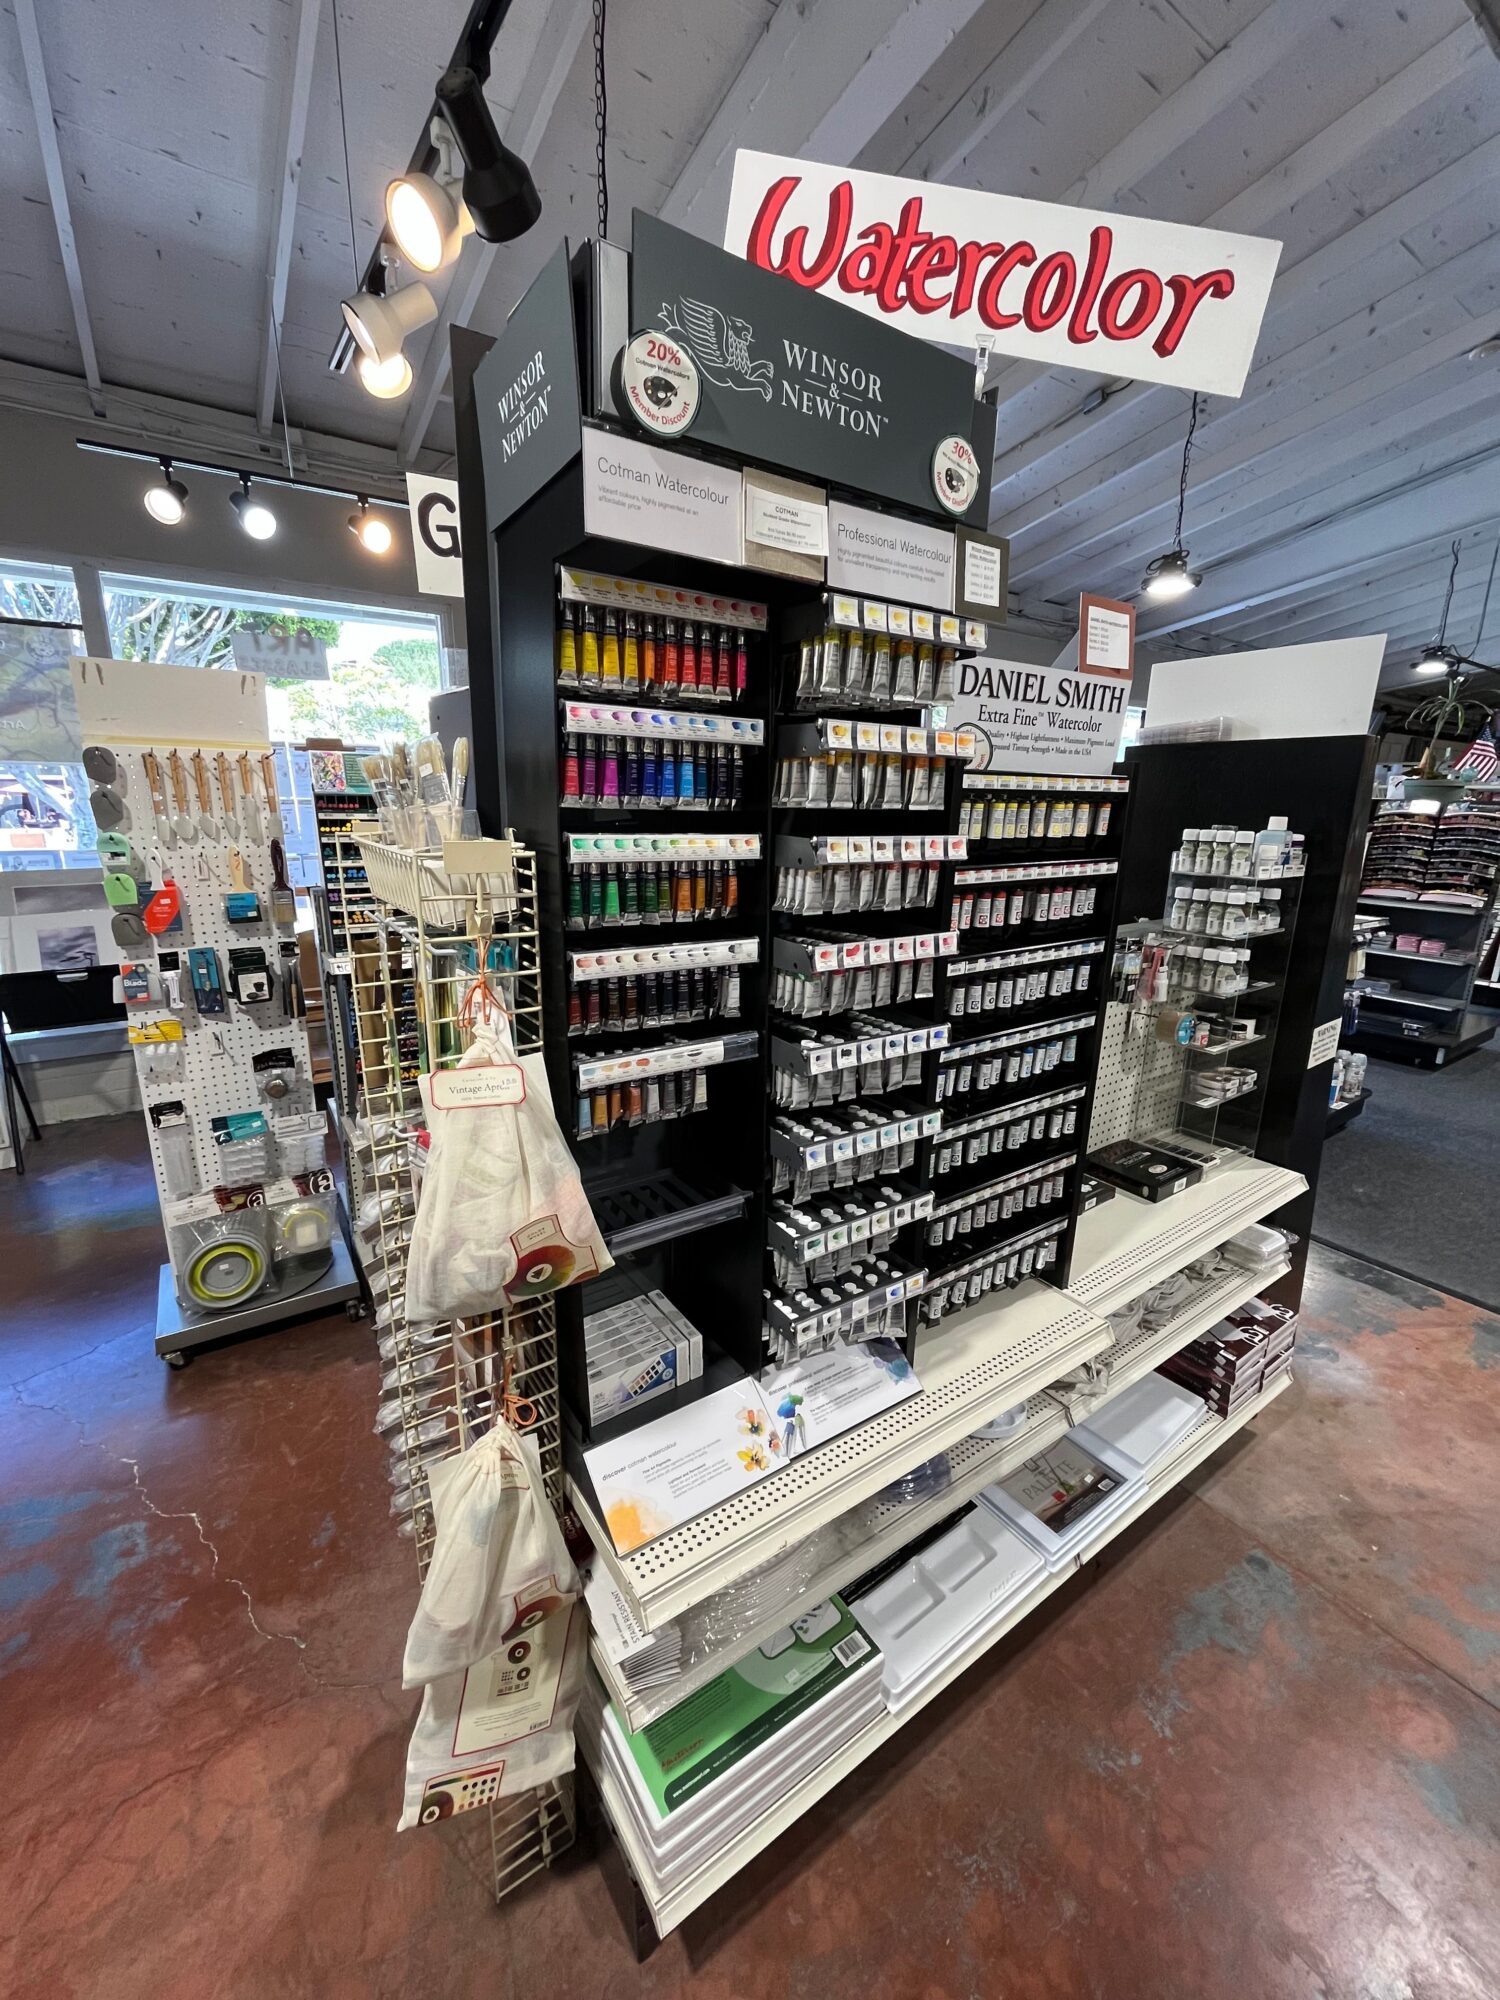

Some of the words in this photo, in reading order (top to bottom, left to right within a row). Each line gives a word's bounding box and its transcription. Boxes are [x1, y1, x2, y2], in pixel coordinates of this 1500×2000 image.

[747, 176, 1235, 358] Watercolor
[646, 340, 681, 366] 20%
[498, 351, 546, 423] WINSOR
[783, 339, 882, 402] WINSOR
[630, 385, 660, 423] Member
[661, 401, 690, 426] Discount
[829, 383, 840, 399] &
[519, 403, 526, 417] &
[951, 441, 972, 465] 30%
[597, 456, 650, 484] Cotman
[655, 472, 729, 505] Watercolour
[775, 506, 799, 518] COTMAN
[837, 523, 897, 551] Professional
[900, 540, 951, 564] Watercolour
[958, 664, 1050, 705] DANIEL
[1055, 677, 1125, 713] SMITH
[978, 704, 1009, 724] Extra
[1047, 711, 1102, 732] Watercolor
[449, 1083, 482, 1095] Vintage
[602, 1466, 626, 1481] discover
[627, 1456, 647, 1469] cotman
[648, 1441, 677, 1459] watercolour
[611, 1591, 630, 1624] RESISTANT
[626, 1622, 640, 1644] STAIN
